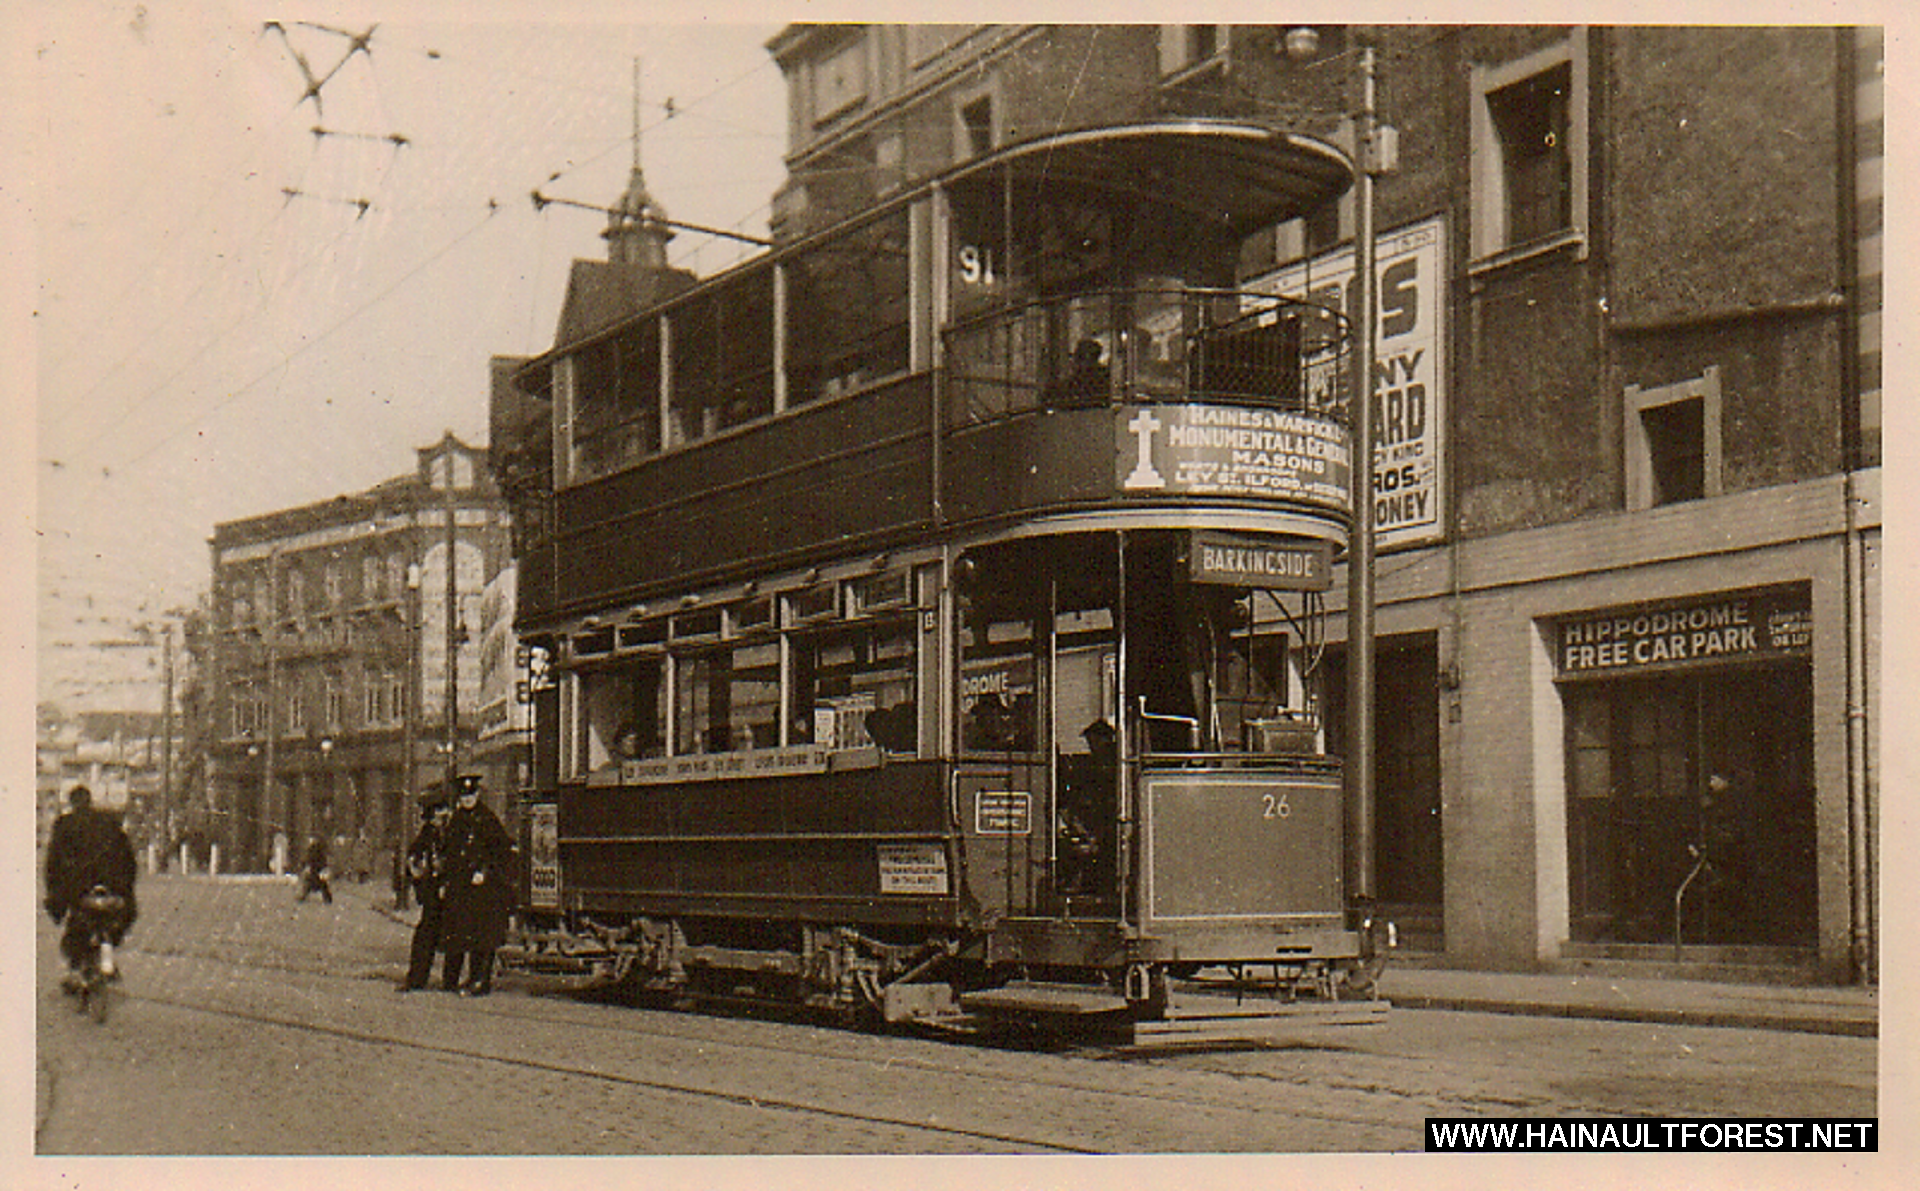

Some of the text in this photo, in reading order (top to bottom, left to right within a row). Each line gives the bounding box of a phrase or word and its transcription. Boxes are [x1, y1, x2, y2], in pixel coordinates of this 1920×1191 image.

[960, 246, 993, 285] 91
[1169, 424, 1294, 452] MONUMENTAL
[1232, 450, 1325, 474] MASONS
[1203, 547, 1314, 577] BARKINGSIDE
[1565, 602, 1749, 645] HIPPODROME
[1565, 643, 1629, 670] FREE
[1634, 634, 1688, 664] CAR
[1690, 625, 1758, 657] PARK
[1262, 794, 1290, 819] 26
